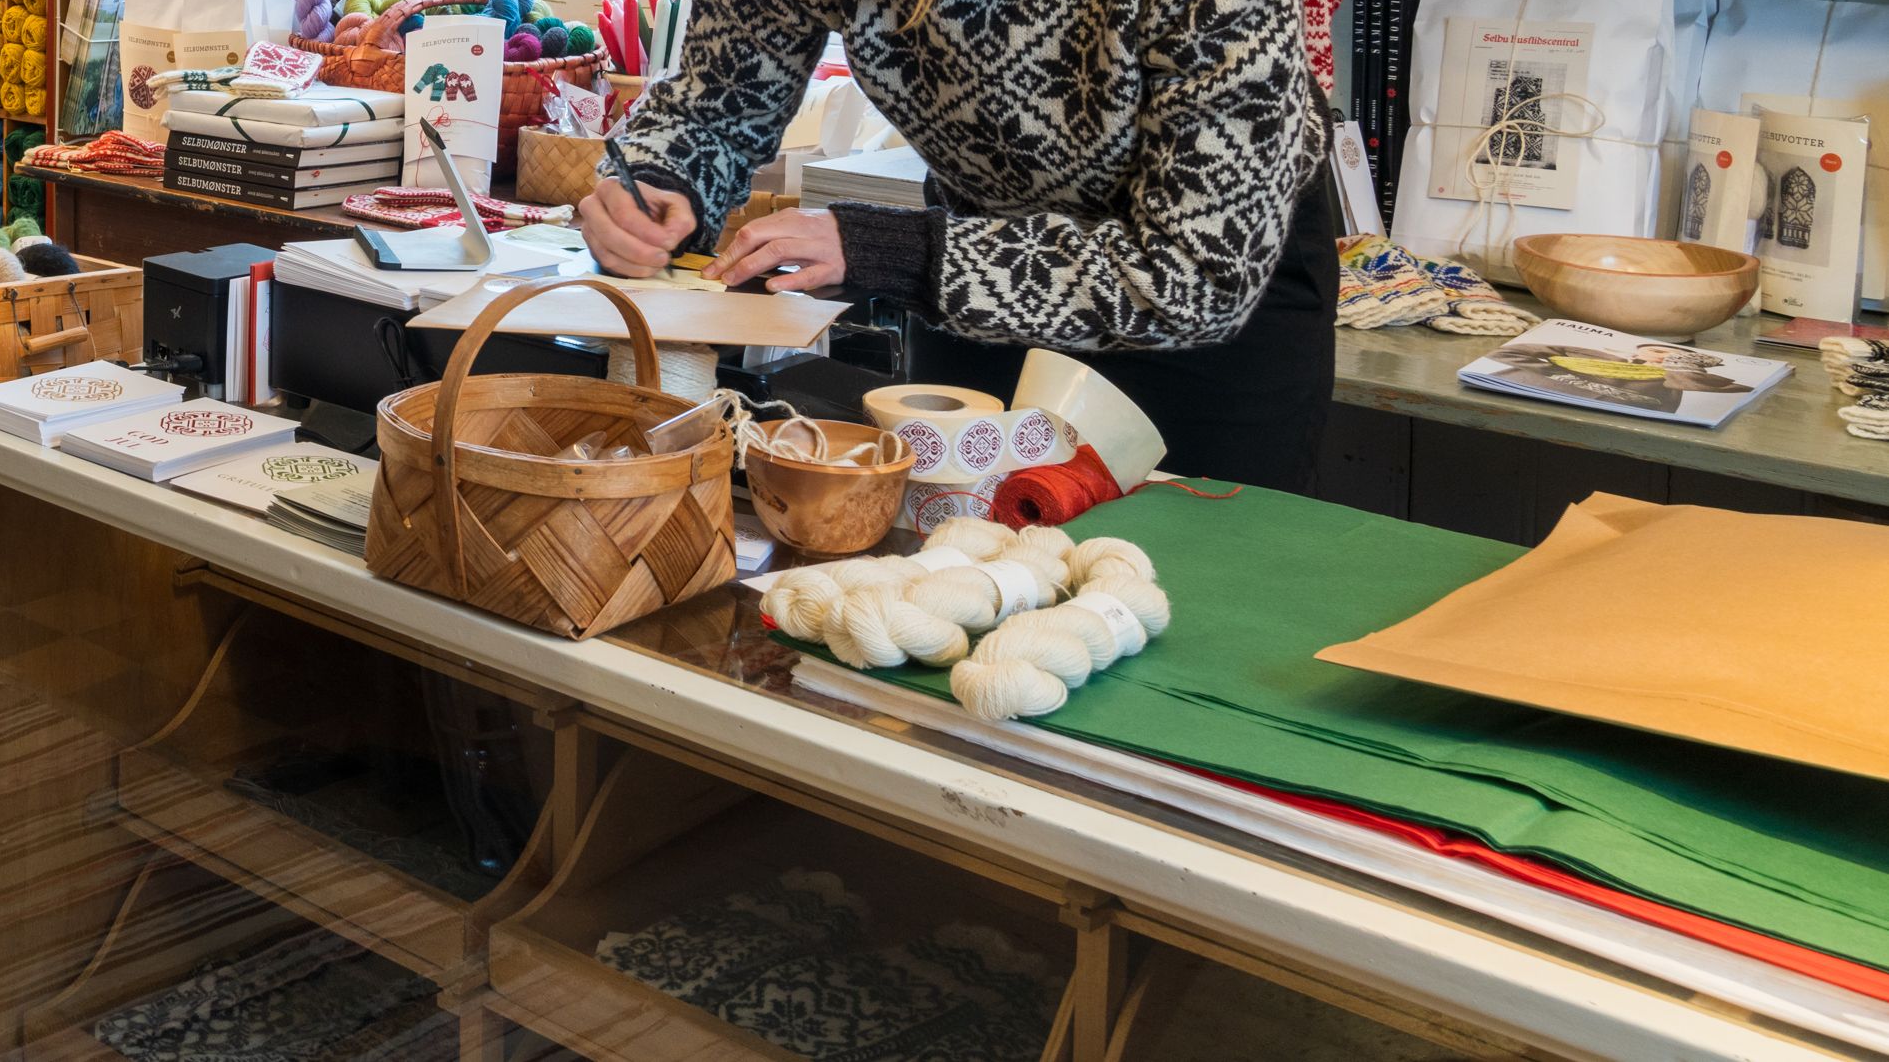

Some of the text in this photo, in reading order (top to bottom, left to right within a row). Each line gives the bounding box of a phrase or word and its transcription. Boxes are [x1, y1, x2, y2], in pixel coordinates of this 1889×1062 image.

[128, 36, 171, 48] SELBUMØNSTER
[421, 37, 470, 48] SELBUVOTTER
[1482, 33, 1509, 43] Selbu
[183, 44, 230, 53] SELBUMØNSTER
[1387, 49, 1399, 80] FLOR
[181, 136, 247, 154] SELBUMØNSTER
[178, 156, 242, 175] SELBUMØNSTER
[177, 176, 242, 196] SELBUMØNSTER
[1555, 322, 1614, 337] RAUMA
[110, 437, 140, 449] JUL
[127, 430, 170, 446] GOD
